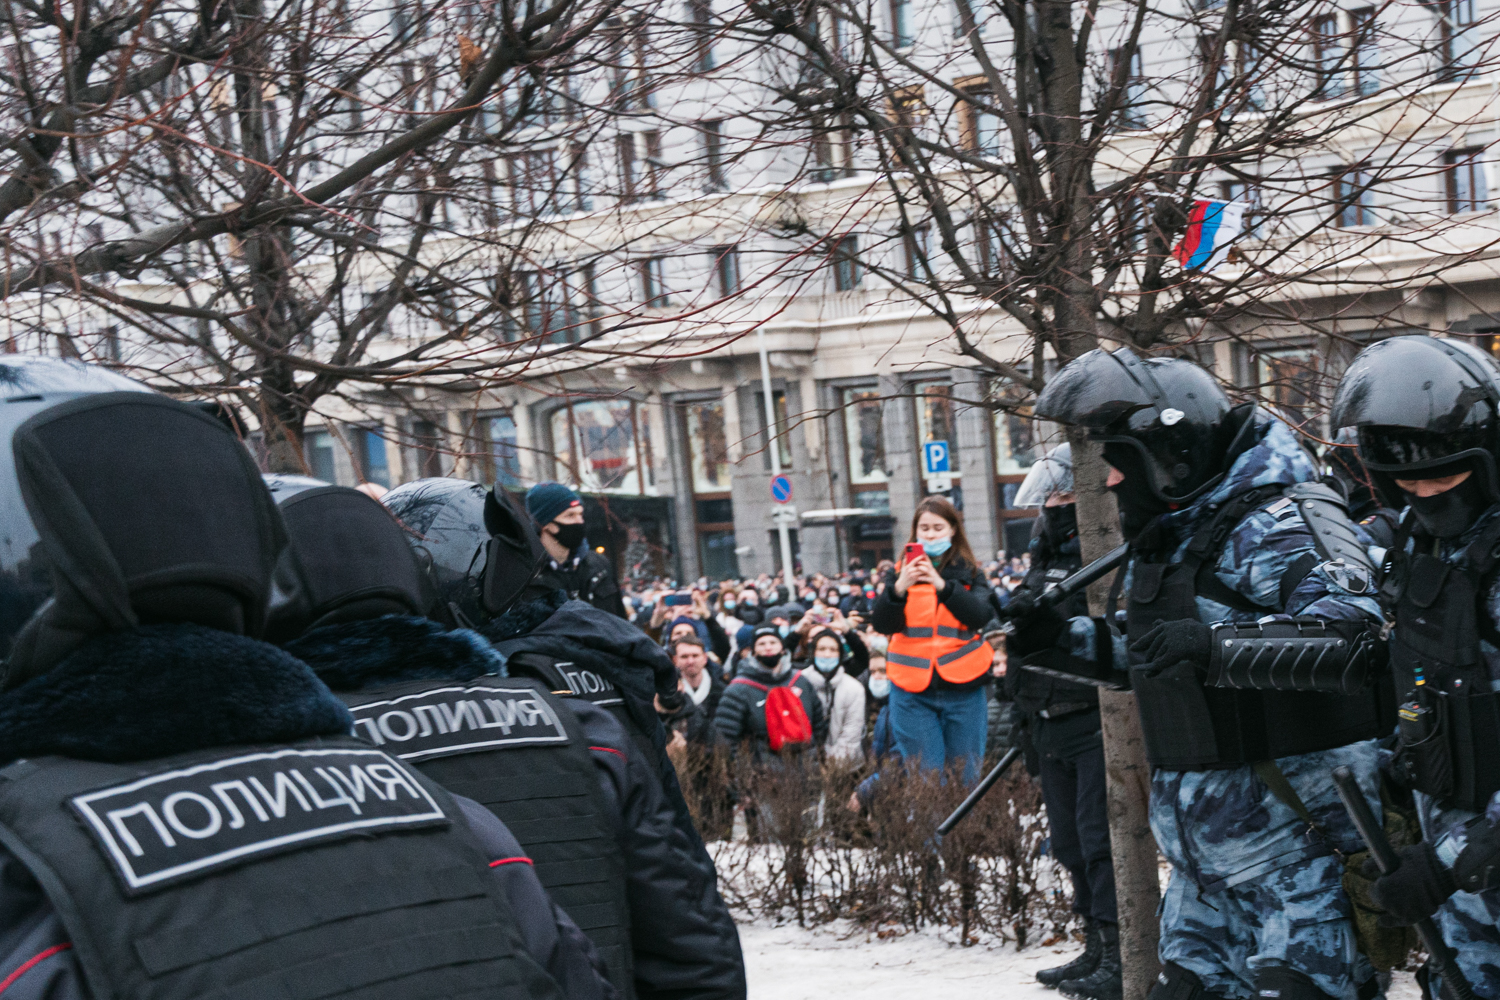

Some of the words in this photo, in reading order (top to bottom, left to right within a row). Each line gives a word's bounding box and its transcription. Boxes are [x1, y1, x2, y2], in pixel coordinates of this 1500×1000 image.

[929, 444, 945, 471] P
[351, 698, 554, 746] ПОЛИЦИЯ
[106, 763, 420, 857] ПОЛИЦИЯ
